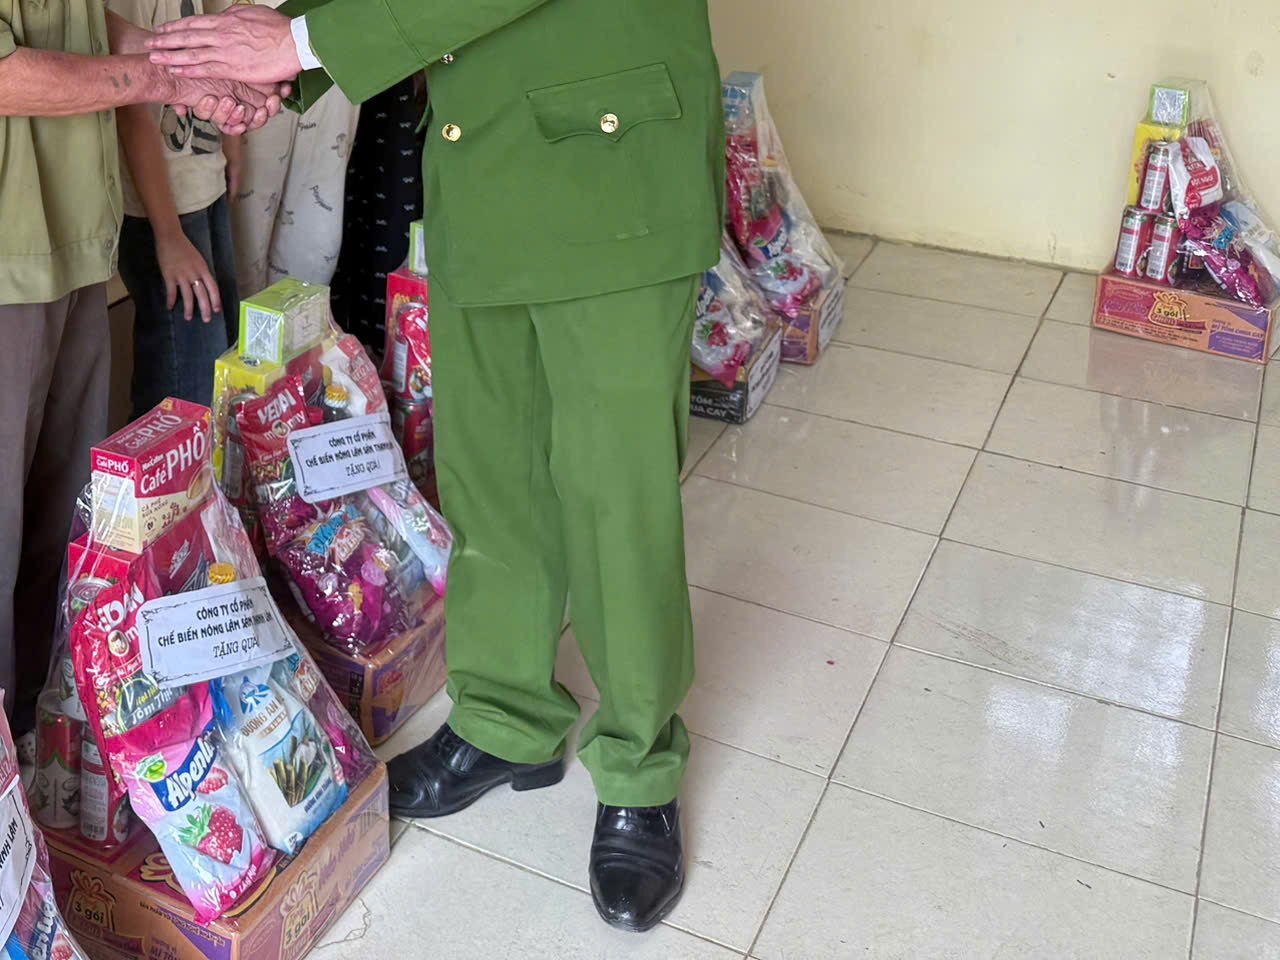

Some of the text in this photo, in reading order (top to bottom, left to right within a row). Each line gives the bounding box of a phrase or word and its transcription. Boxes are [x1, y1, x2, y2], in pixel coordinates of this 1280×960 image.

[140, 421, 206, 495] Café PHỐ
[196, 606, 219, 621] CÔNG
[220, 604, 229, 616] TY
[230, 597, 239, 613] CỔ
[158, 629, 176, 647] CHẾ
[177, 626, 199, 643] BIẾN
[200, 623, 224, 639] NÔNG
[225, 618, 241, 633] LÂM
[213, 641, 239, 659] TẶNG
[7, 817, 18, 843] LÂM
[74, 902, 82, 913] 3
